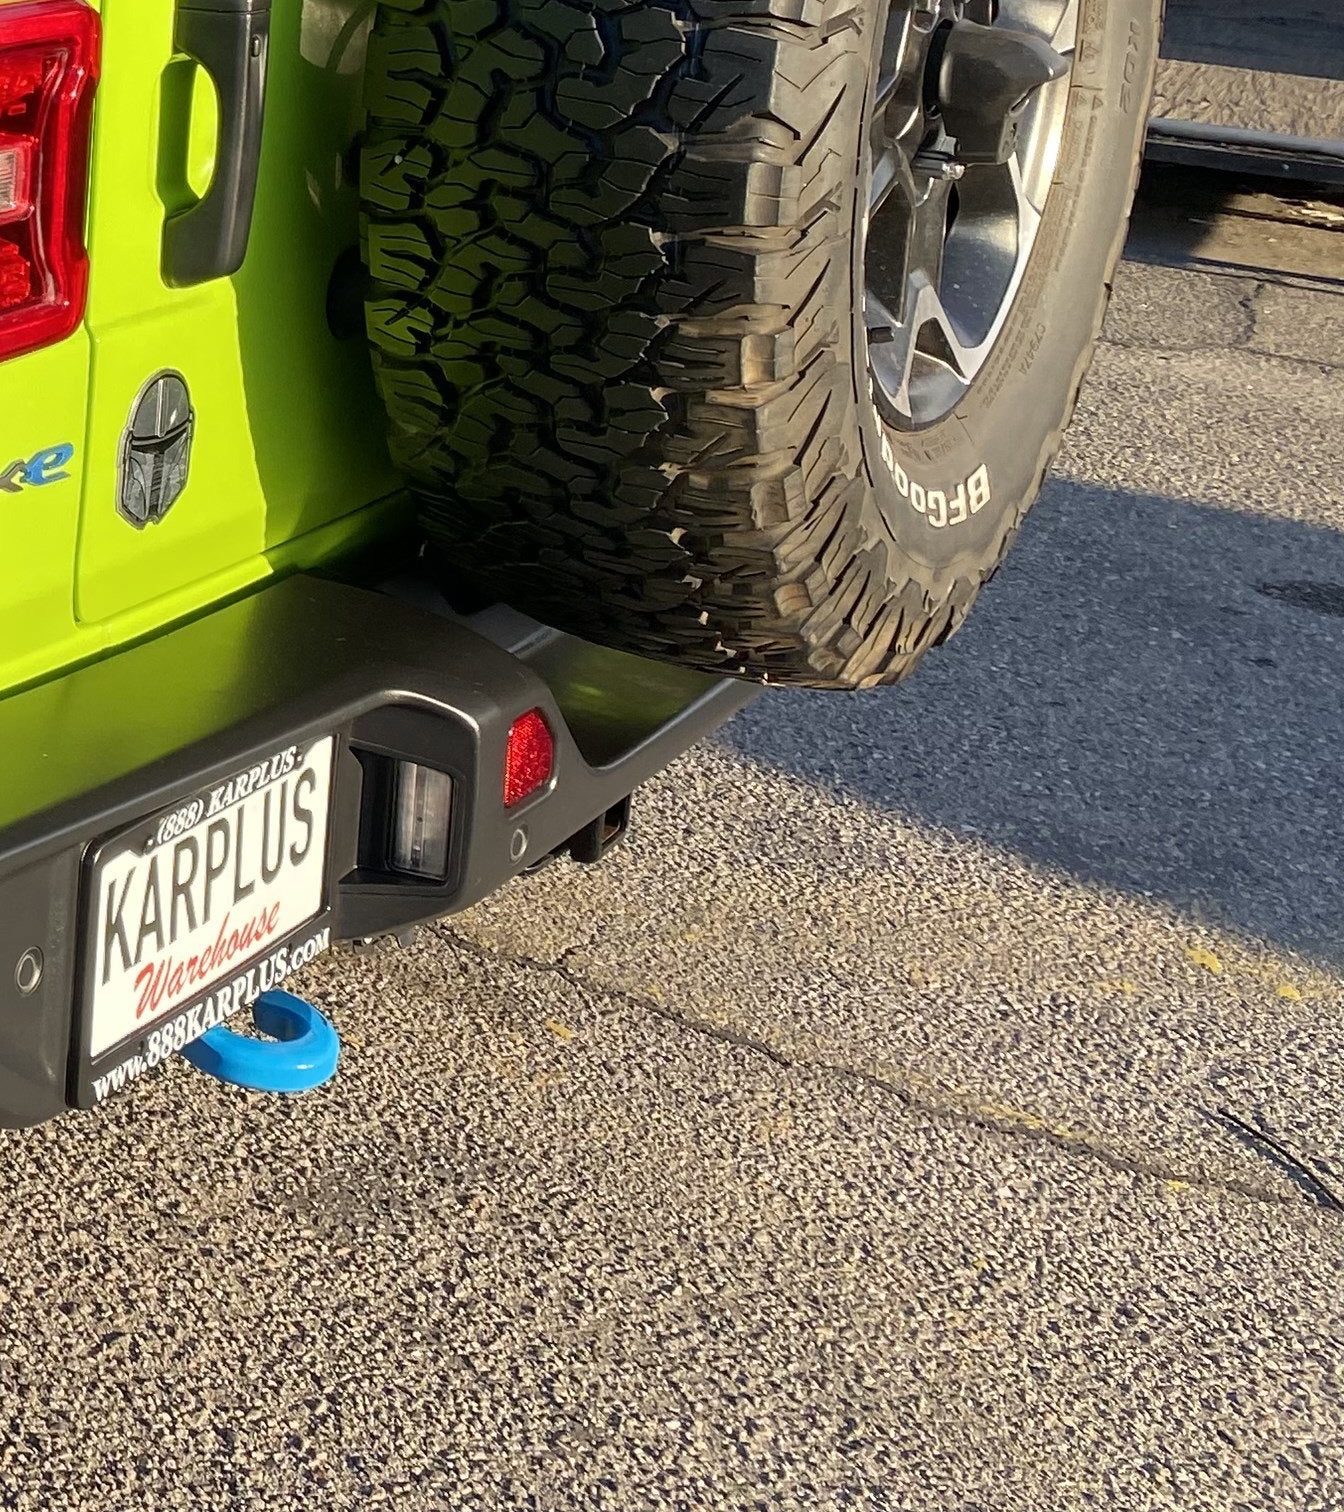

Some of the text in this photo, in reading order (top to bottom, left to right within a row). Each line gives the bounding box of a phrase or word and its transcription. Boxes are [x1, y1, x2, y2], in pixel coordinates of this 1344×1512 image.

[155, 745, 298, 846] (888) KARPLUS
[102, 766, 317, 987] KARPLUS
[133, 901, 281, 1020] Warehouse
